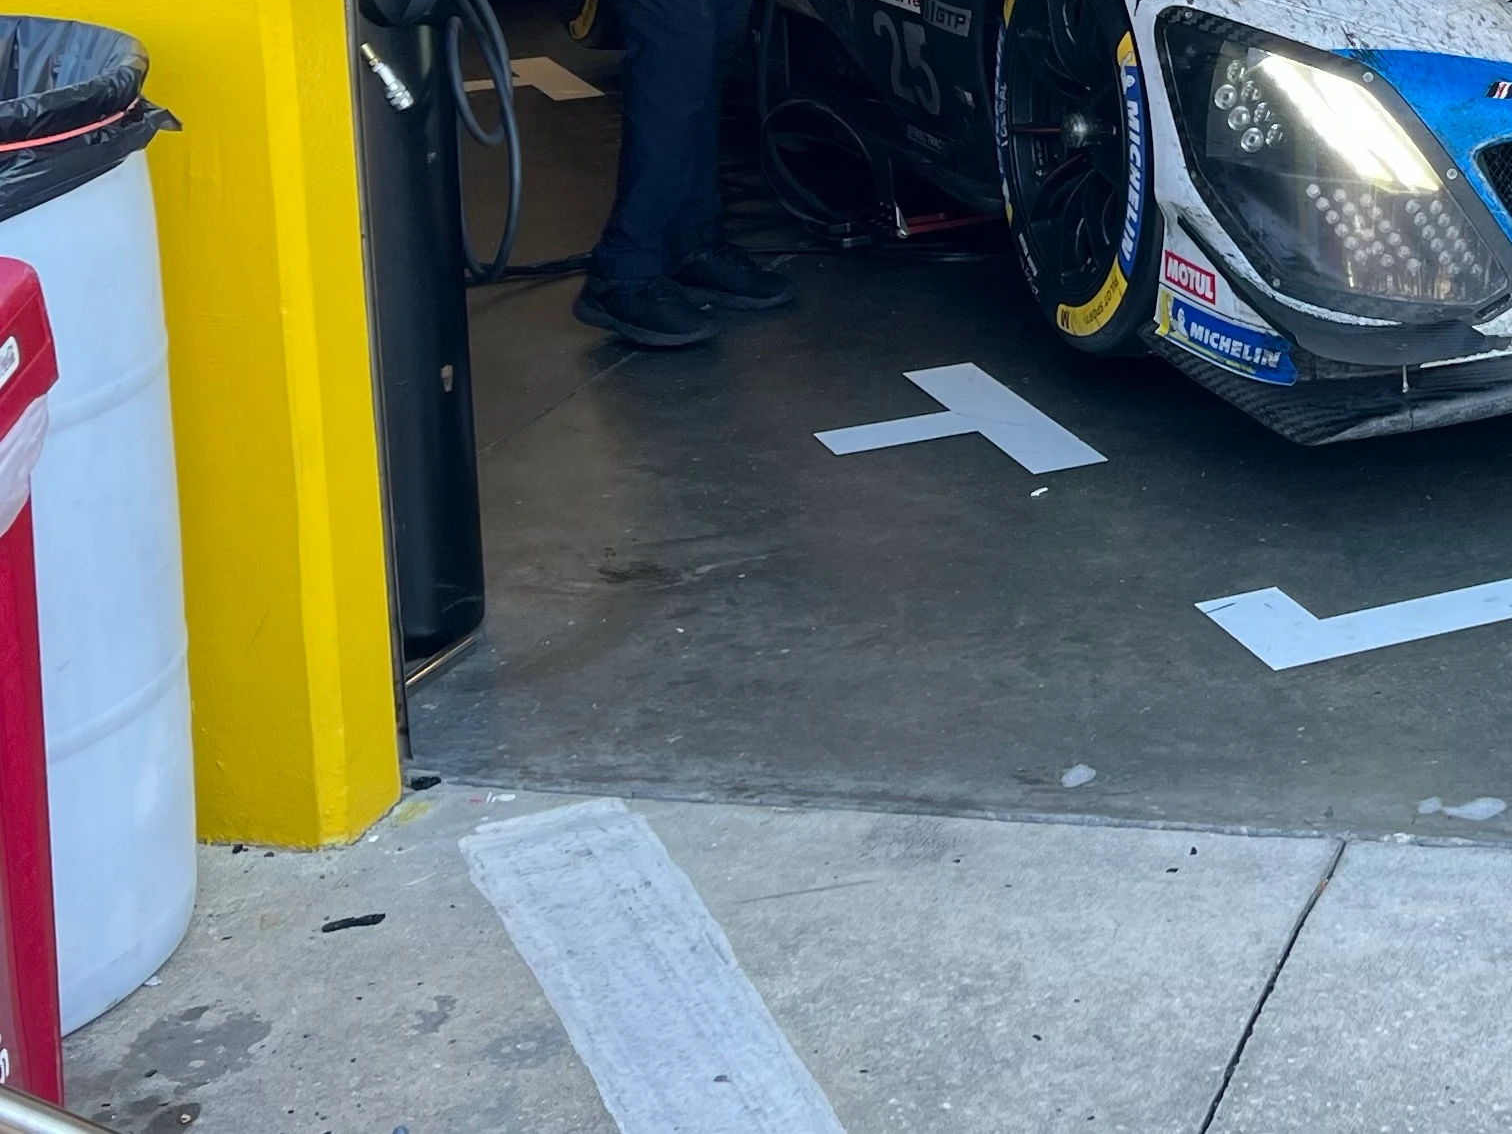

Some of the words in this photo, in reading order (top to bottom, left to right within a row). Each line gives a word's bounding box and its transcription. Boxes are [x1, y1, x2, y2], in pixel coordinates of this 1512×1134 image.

[935, 8, 967, 30] GTP
[872, 9, 942, 116] 25
[1120, 100, 1143, 262] MICHELIN
[1166, 255, 1214, 301] MOTUL
[1189, 321, 1282, 369] MICHELIN
